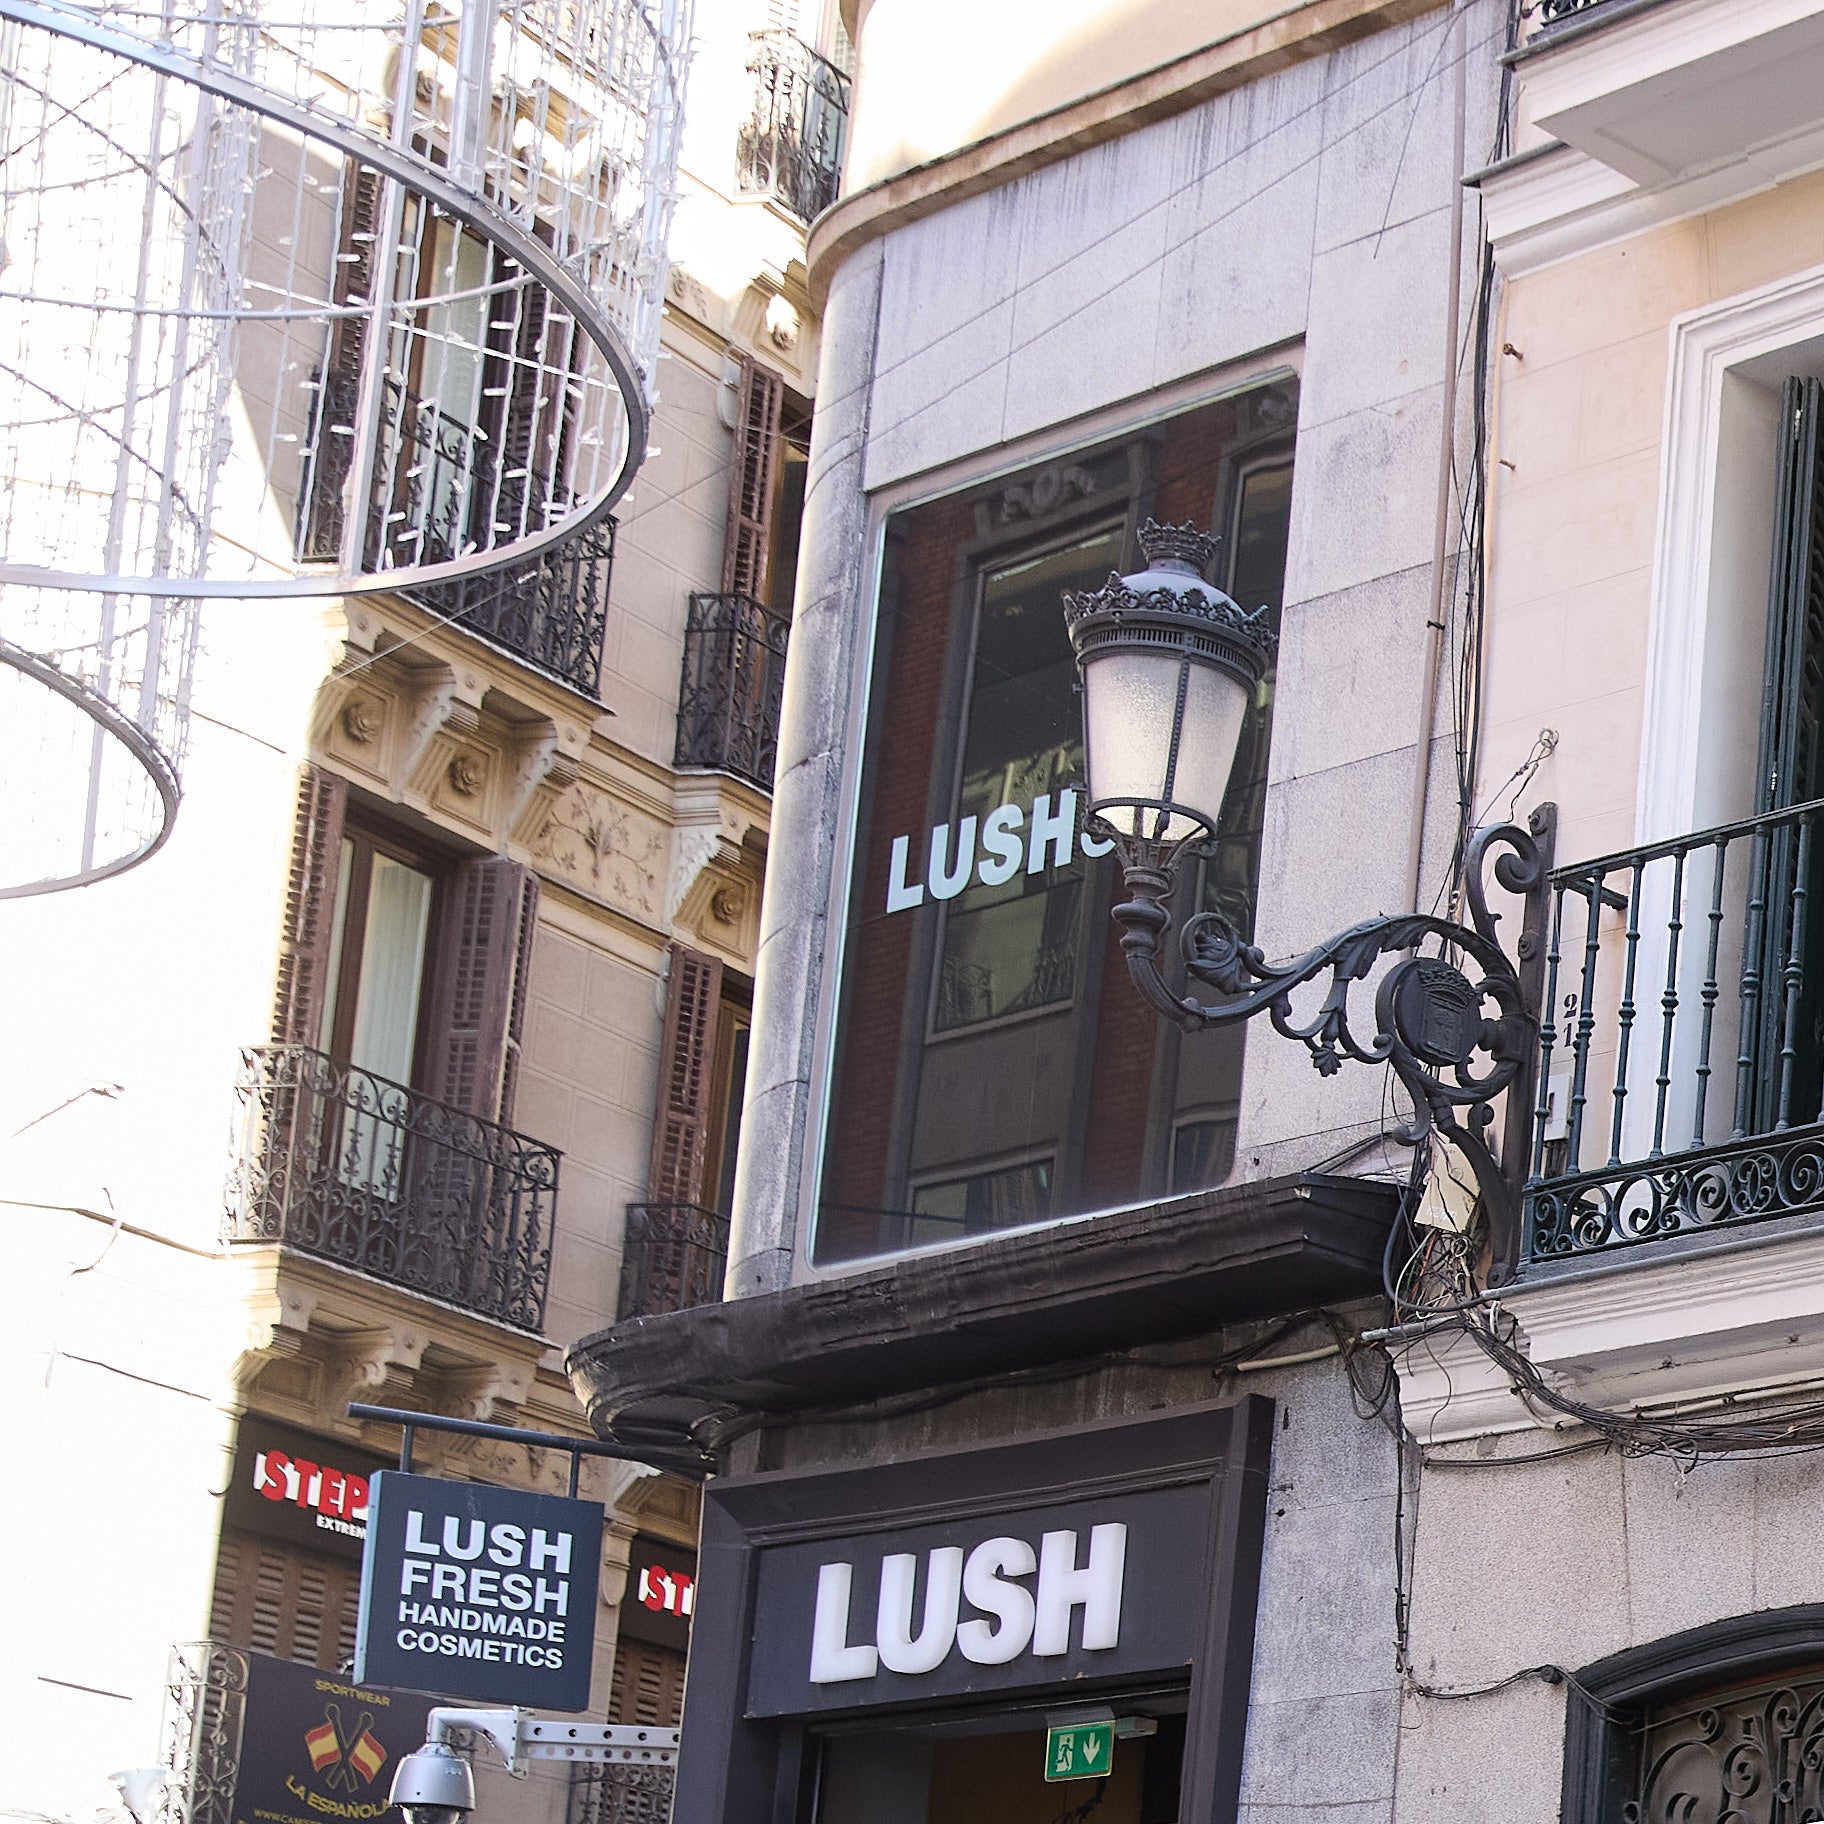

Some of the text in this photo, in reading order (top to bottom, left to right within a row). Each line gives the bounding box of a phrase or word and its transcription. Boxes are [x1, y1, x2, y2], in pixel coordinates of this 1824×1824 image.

[886, 789, 1077, 913] LUSH
[255, 1450, 369, 1521] STEP
[316, 1514, 368, 1540] EXTREM
[405, 1510, 573, 1574] LUSH
[401, 1558, 569, 1617] FRESH
[638, 1564, 694, 1617] ST
[809, 1522, 1127, 1684] LUSH
[399, 1601, 565, 1643] HANDMADE
[397, 1629, 563, 1670] COSMETICS
[315, 1679, 390, 1706] SPORTWEAR
[286, 1775, 391, 1820] LA ESPAÑOLA
